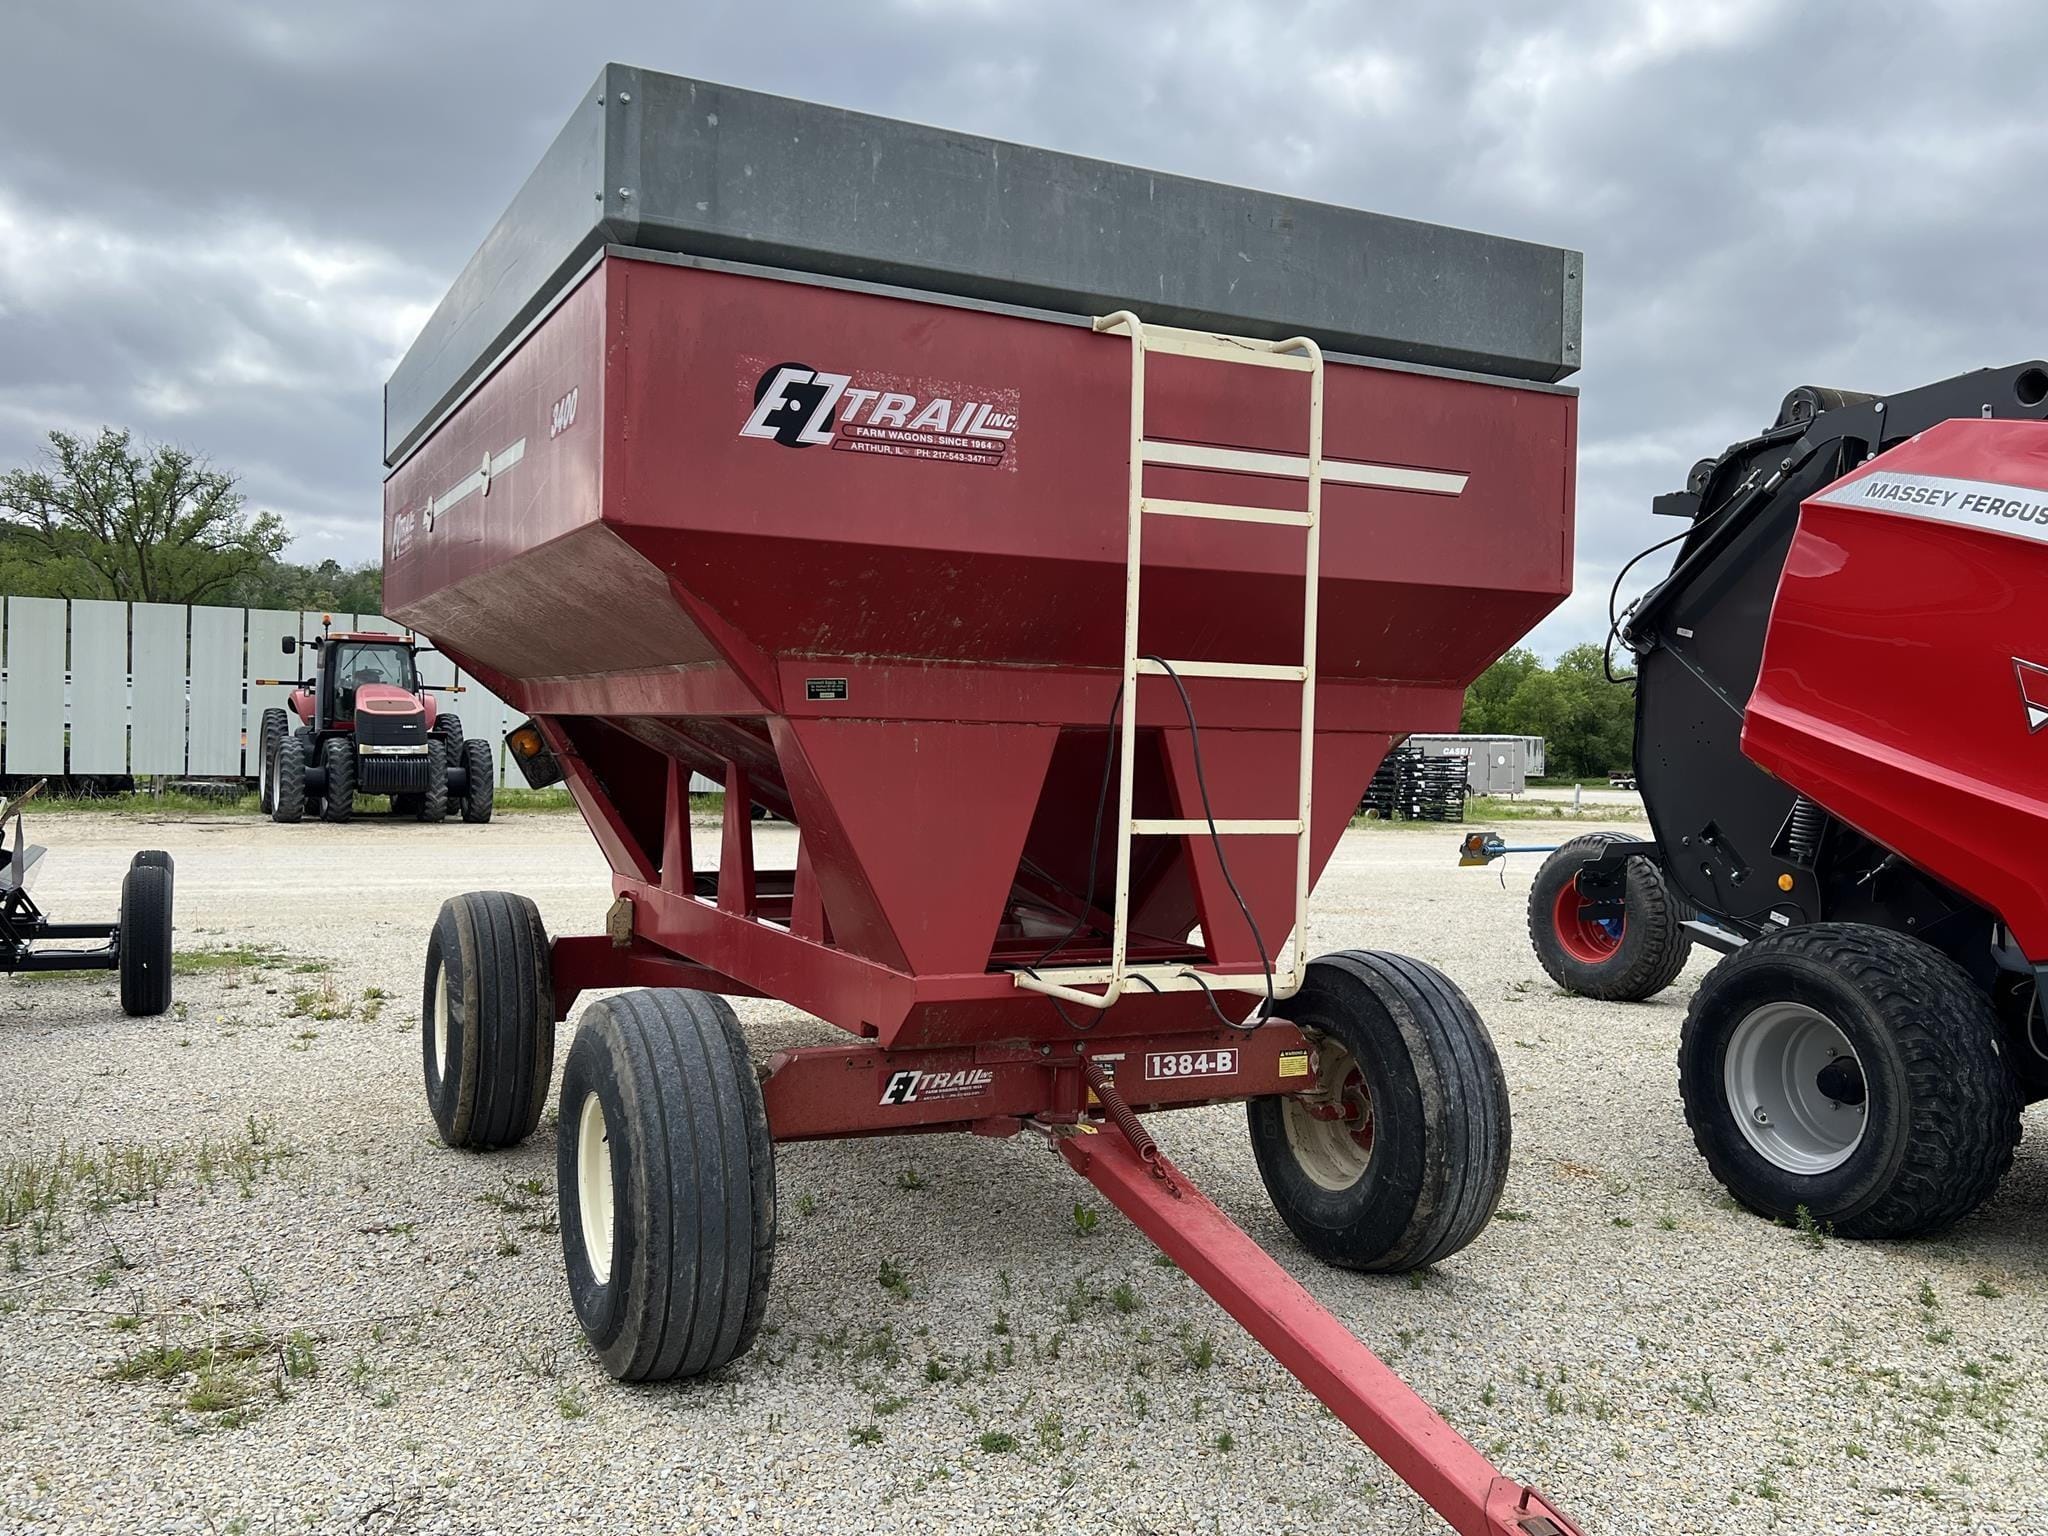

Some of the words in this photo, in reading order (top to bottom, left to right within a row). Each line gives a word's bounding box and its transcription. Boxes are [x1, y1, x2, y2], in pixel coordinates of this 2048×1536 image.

[840, 388, 1013, 439] TRAIL
[856, 427, 886, 438] FARM
[888, 430, 933, 443] WAGONS
[938, 436, 969, 447] SINCE
[971, 440, 992, 449] 1964
[933, 451, 987, 463] 217-543-3471
[1865, 482, 1958, 508] MASSEY
[1152, 1051, 1233, 1076] 1384-B
[919, 1069, 992, 1090] TRAIL
